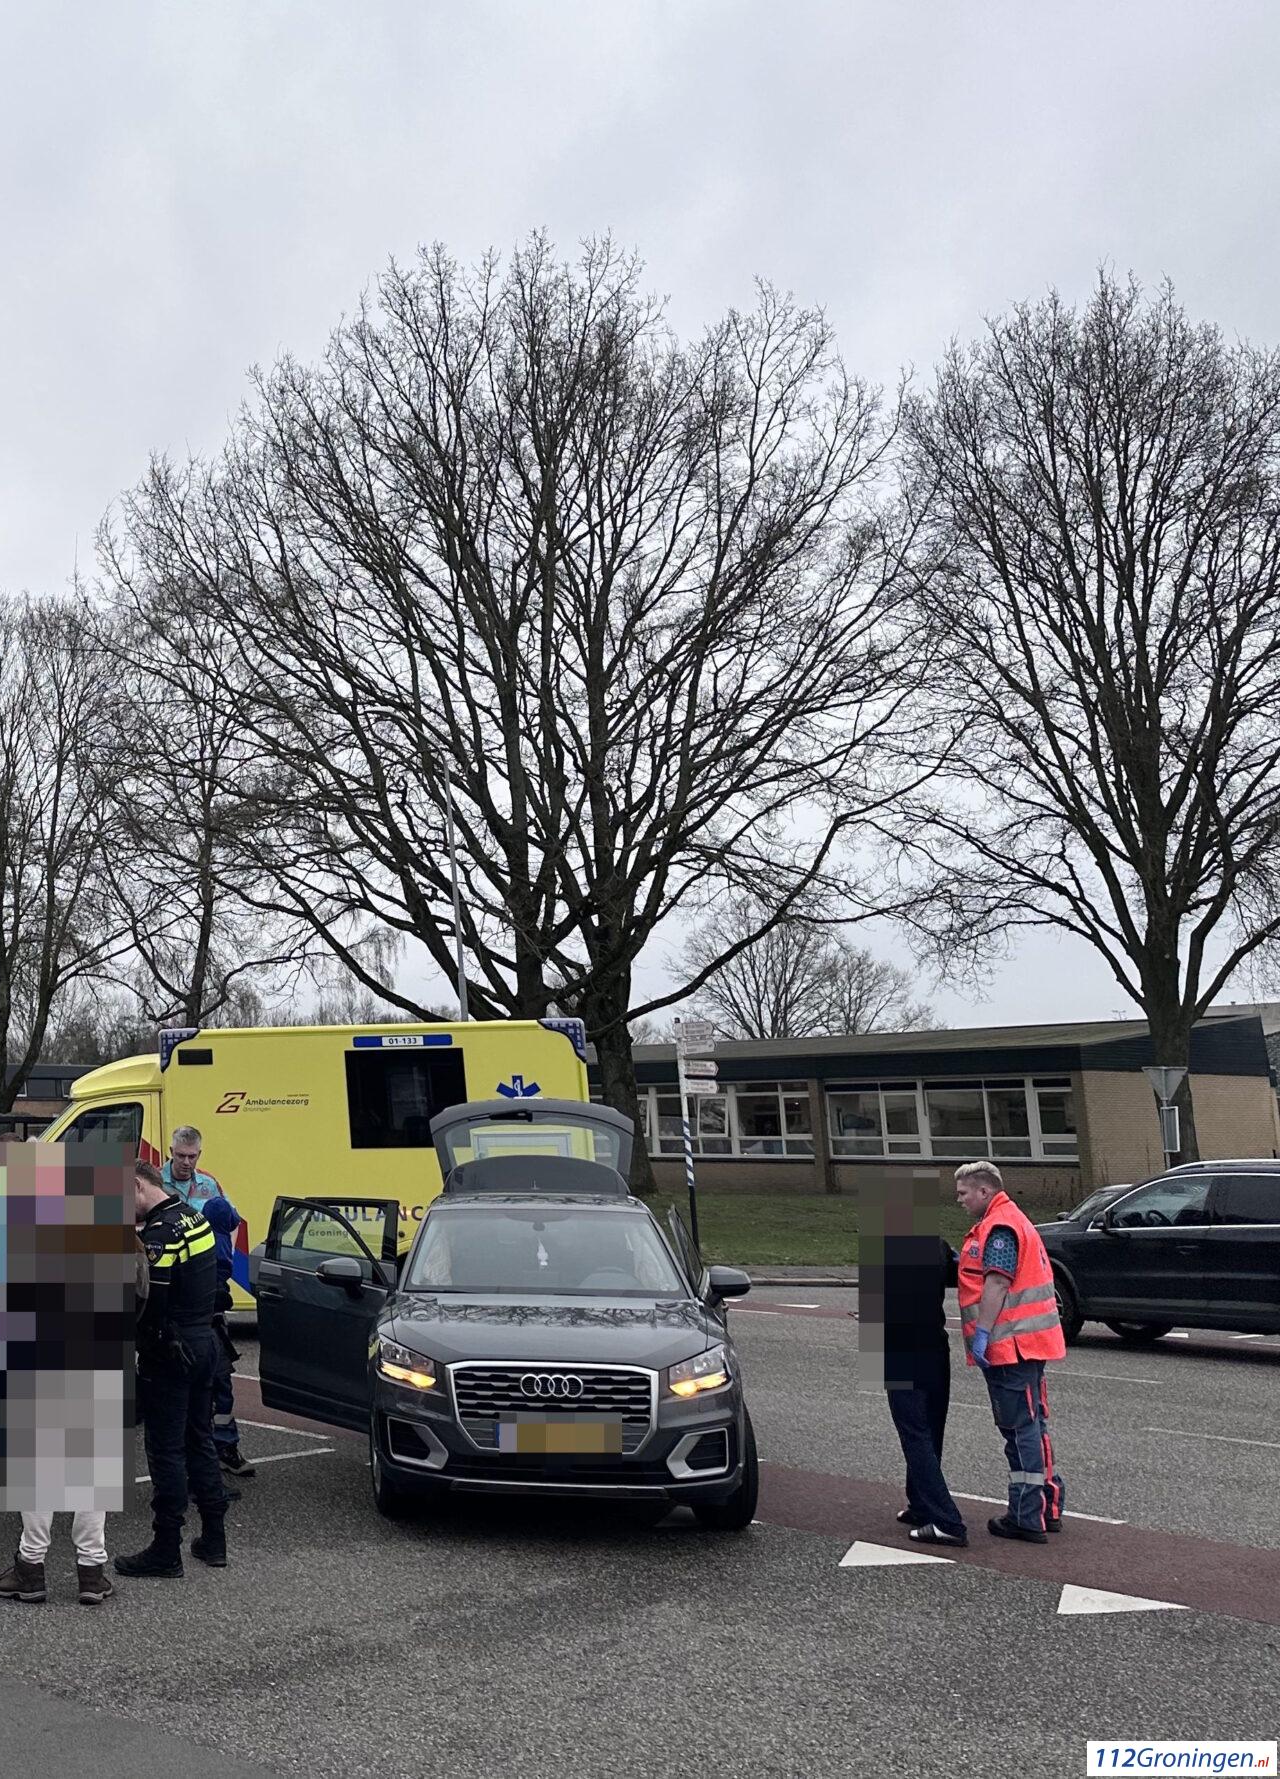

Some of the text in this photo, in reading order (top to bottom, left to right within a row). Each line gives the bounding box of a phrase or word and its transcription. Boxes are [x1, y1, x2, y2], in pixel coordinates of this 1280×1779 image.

[388, 1037, 417, 1045] 01-133
[245, 1098, 309, 1106] Ambulancezorg
[307, 1229, 361, 1239] Groningn
